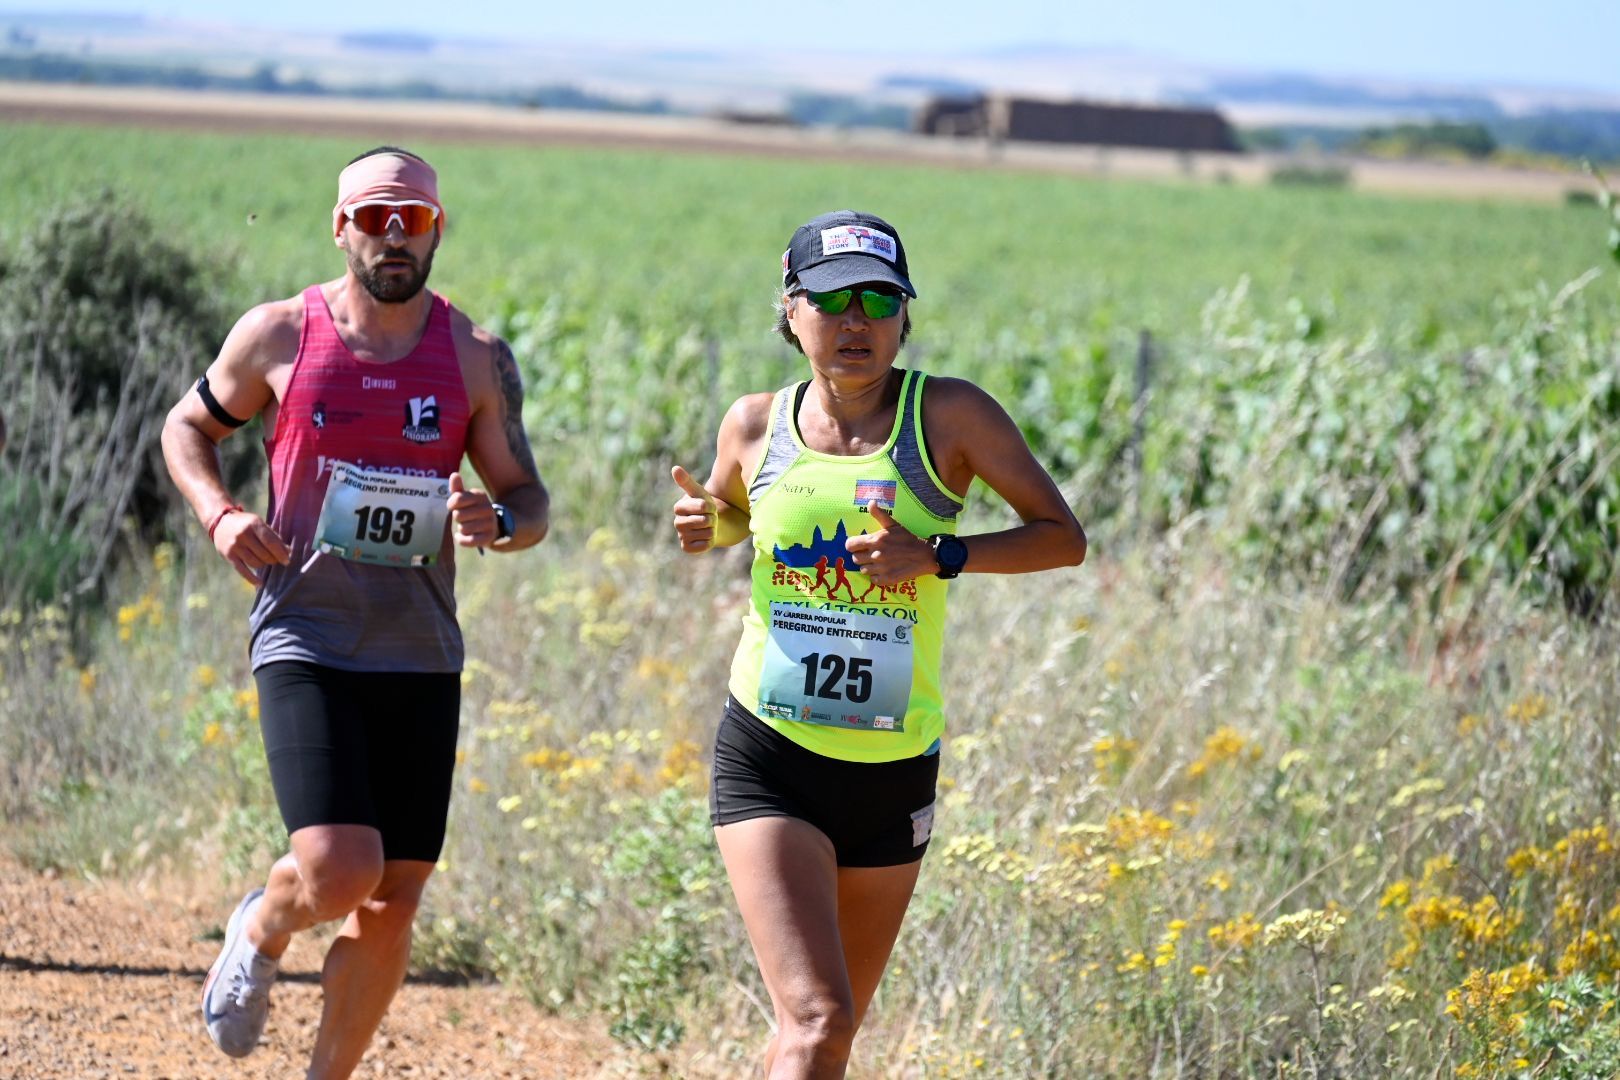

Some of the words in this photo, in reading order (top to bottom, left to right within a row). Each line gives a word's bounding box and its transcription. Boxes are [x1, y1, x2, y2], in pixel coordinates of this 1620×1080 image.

[370, 476, 397, 485] POPULAR
[379, 485, 430, 498] ENTRECEPAS
[354, 505, 416, 547] 193
[773, 609, 783, 617] XV
[783, 610, 813, 621] CARRERA
[814, 615, 847, 625] POPULAR
[773, 619, 824, 635] PEREGRINO
[826, 627, 888, 642] ENTRECEPAS
[800, 652, 873, 704] 125
